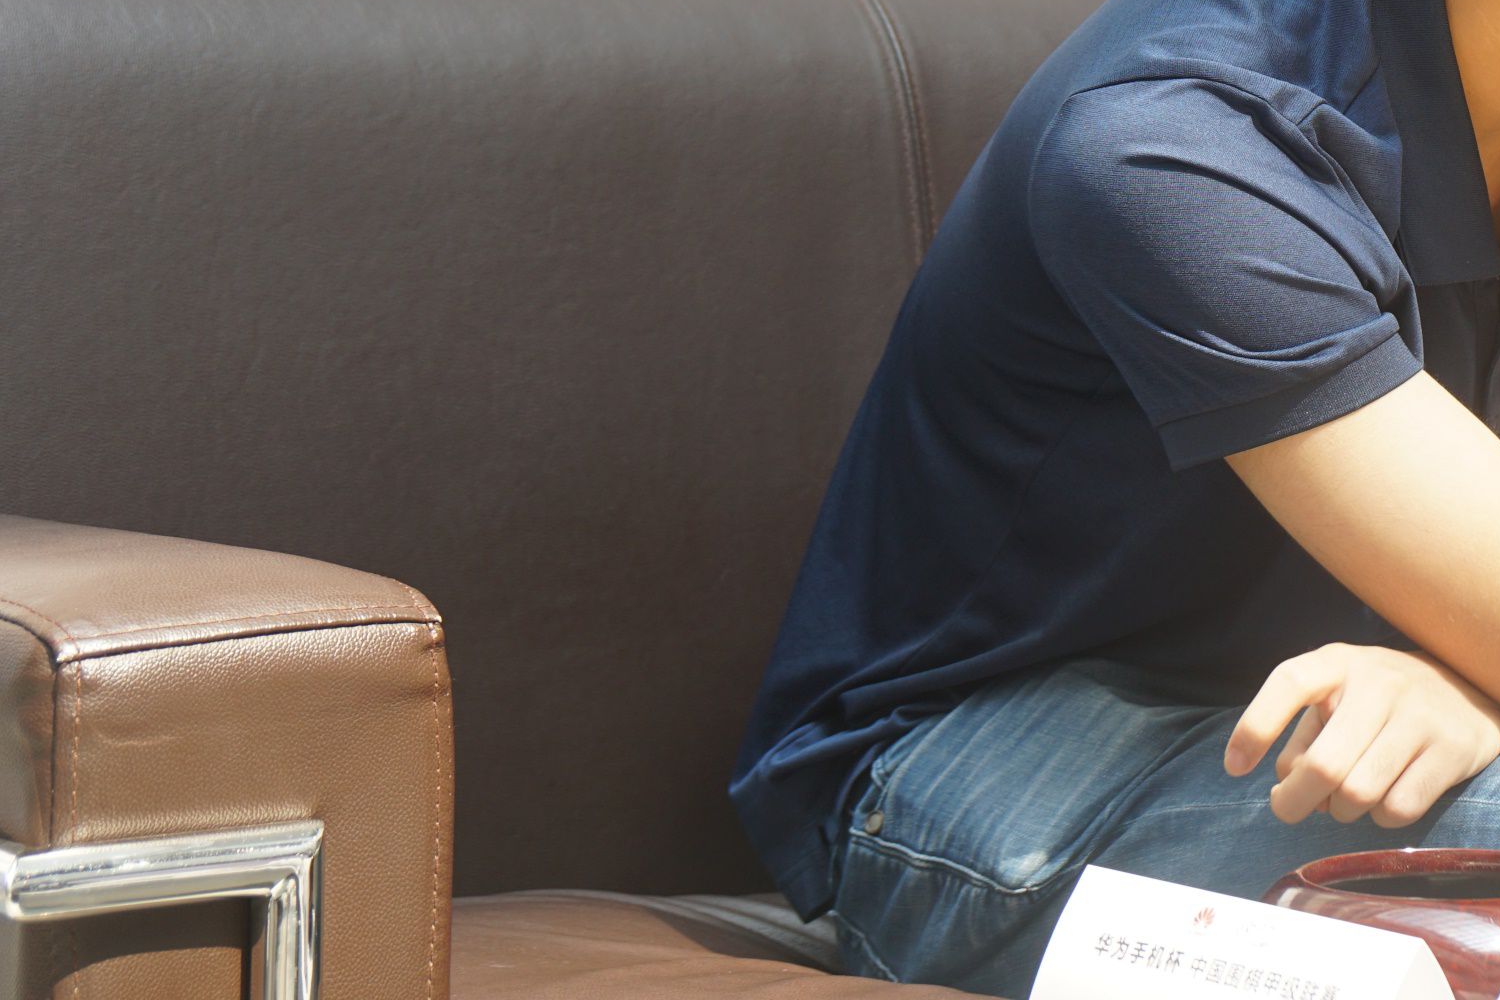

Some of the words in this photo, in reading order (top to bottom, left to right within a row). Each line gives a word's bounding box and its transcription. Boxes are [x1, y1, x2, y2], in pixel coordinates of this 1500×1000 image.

[1094, 933, 1185, 974] 华为手机杯
